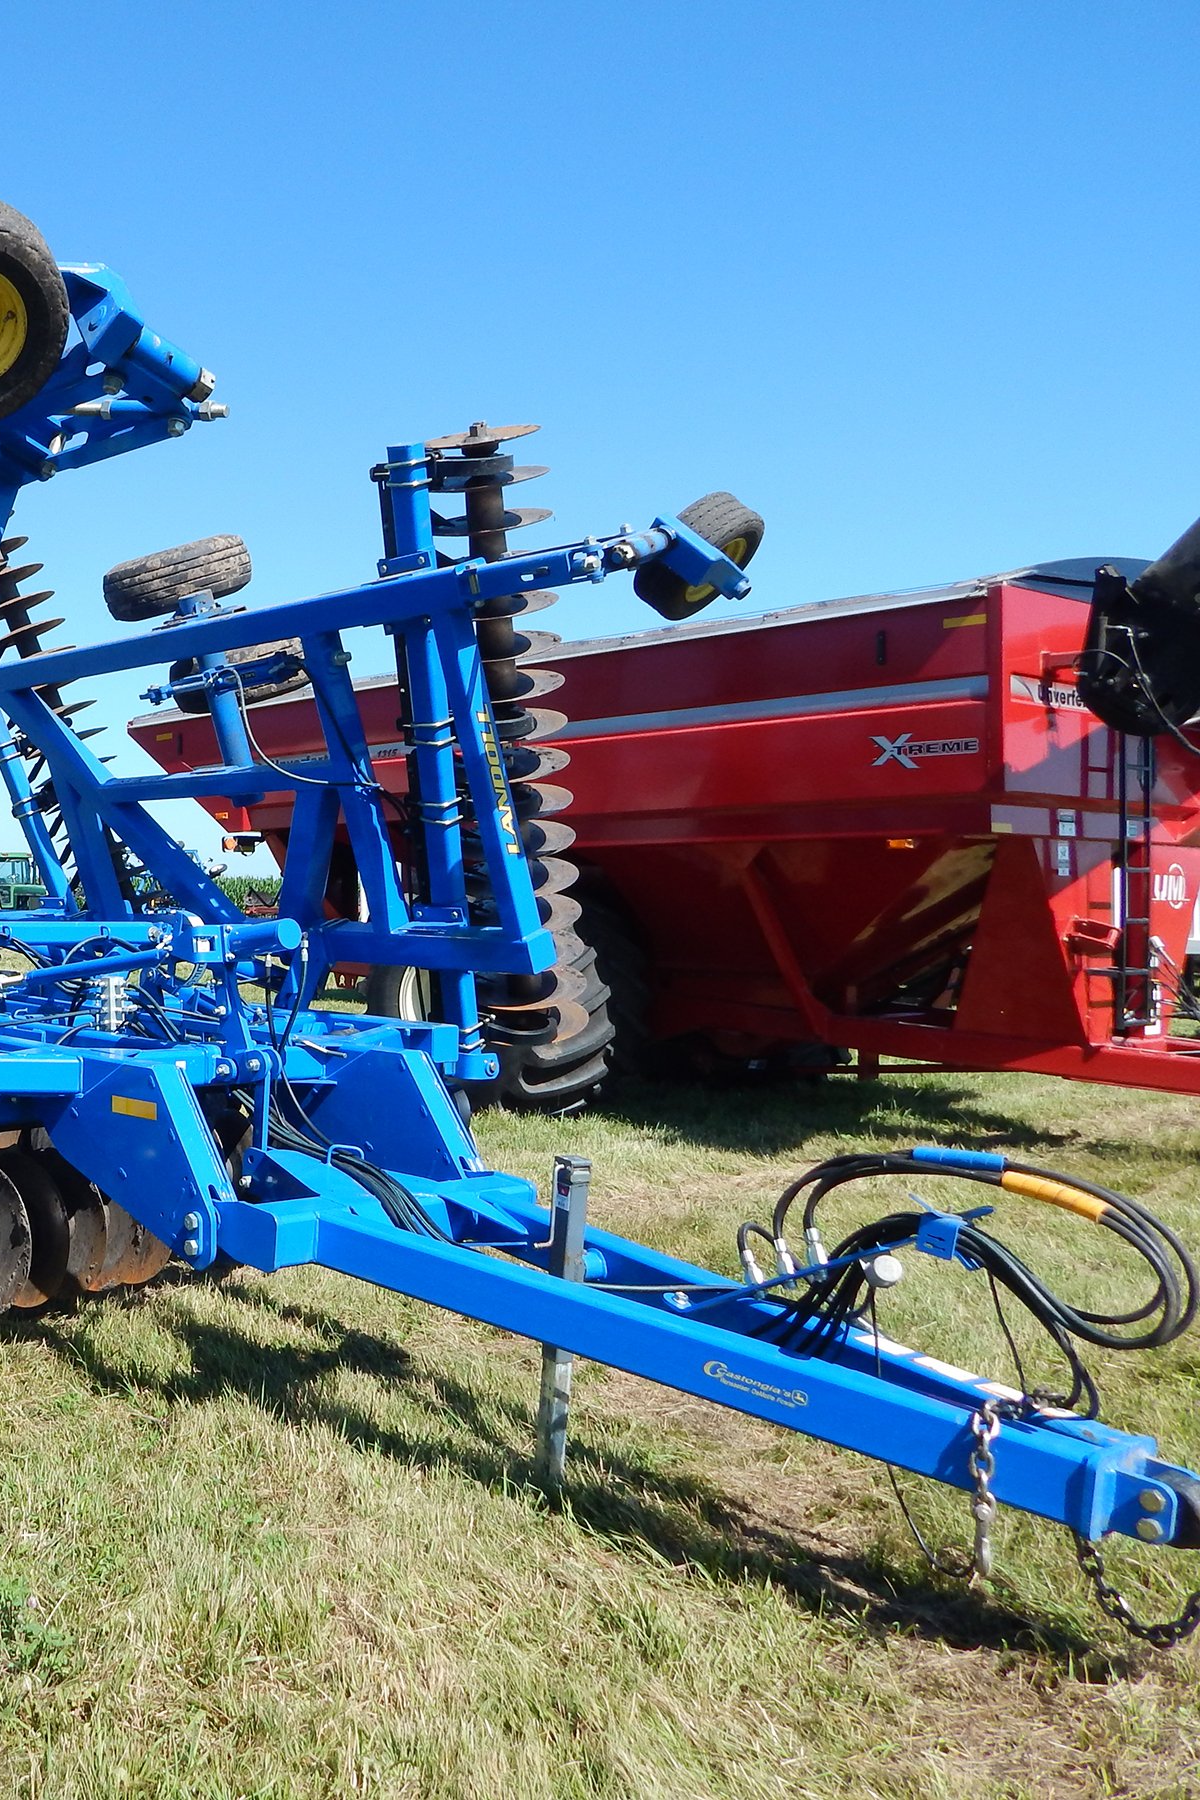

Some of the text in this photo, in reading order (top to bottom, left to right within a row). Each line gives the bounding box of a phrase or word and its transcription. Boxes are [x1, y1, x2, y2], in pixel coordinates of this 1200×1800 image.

[1038, 684, 1087, 707] Unverfe
[869, 733, 978, 768] XTREME
[476, 703, 521, 855] LANDOLL
[703, 1360, 792, 1399] Castongia's
